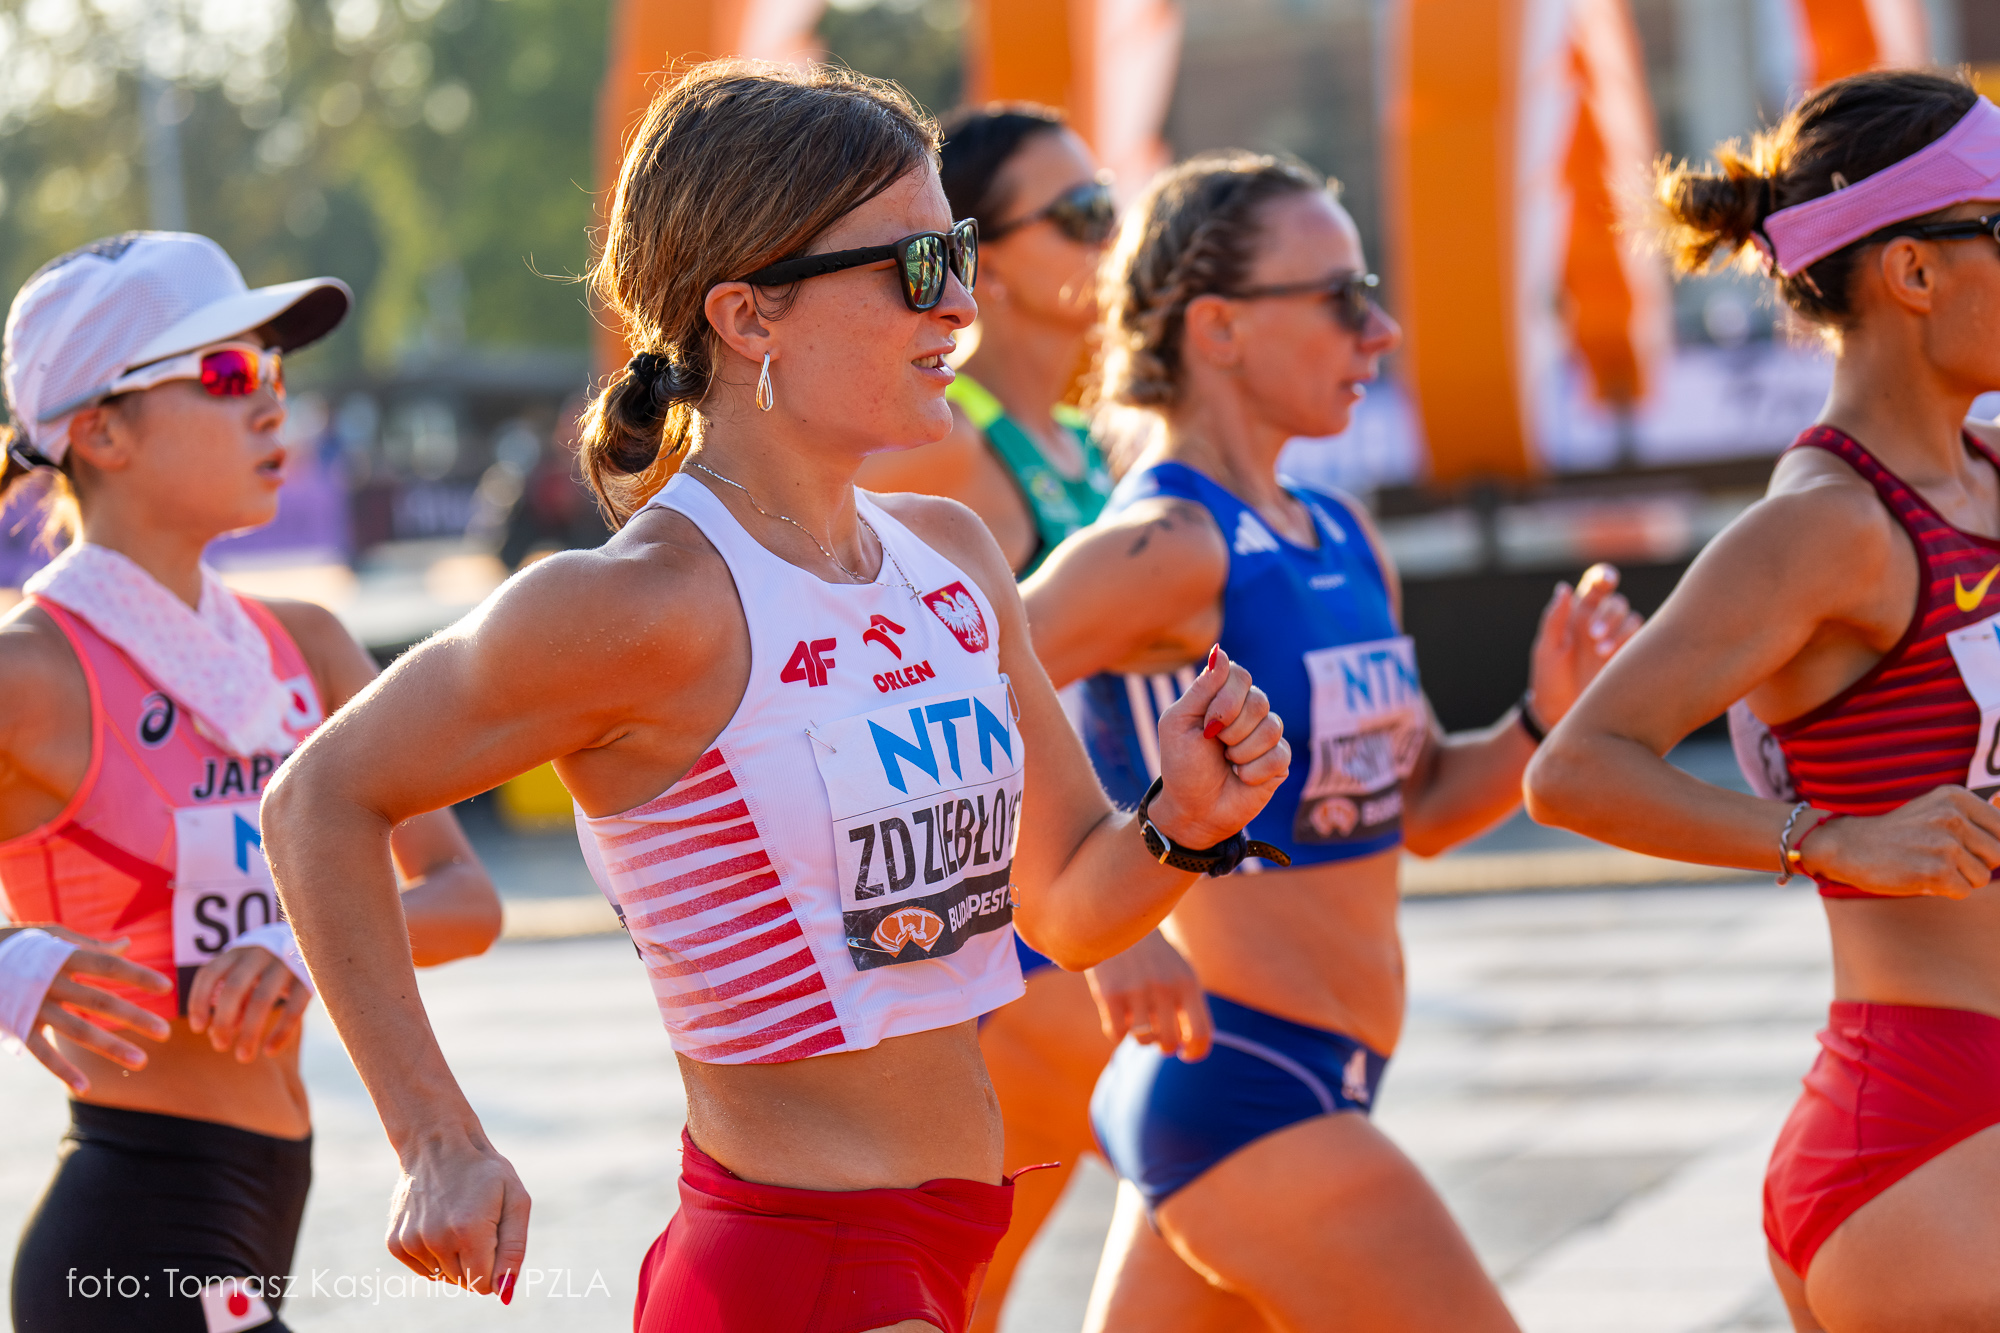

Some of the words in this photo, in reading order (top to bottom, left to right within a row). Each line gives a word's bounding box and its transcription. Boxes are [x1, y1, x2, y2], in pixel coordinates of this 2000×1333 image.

[780, 637, 836, 687] 4F
[872, 659, 936, 694] ORLEN
[866, 690, 1014, 795] NTN
[193, 752, 290, 799] JAP
